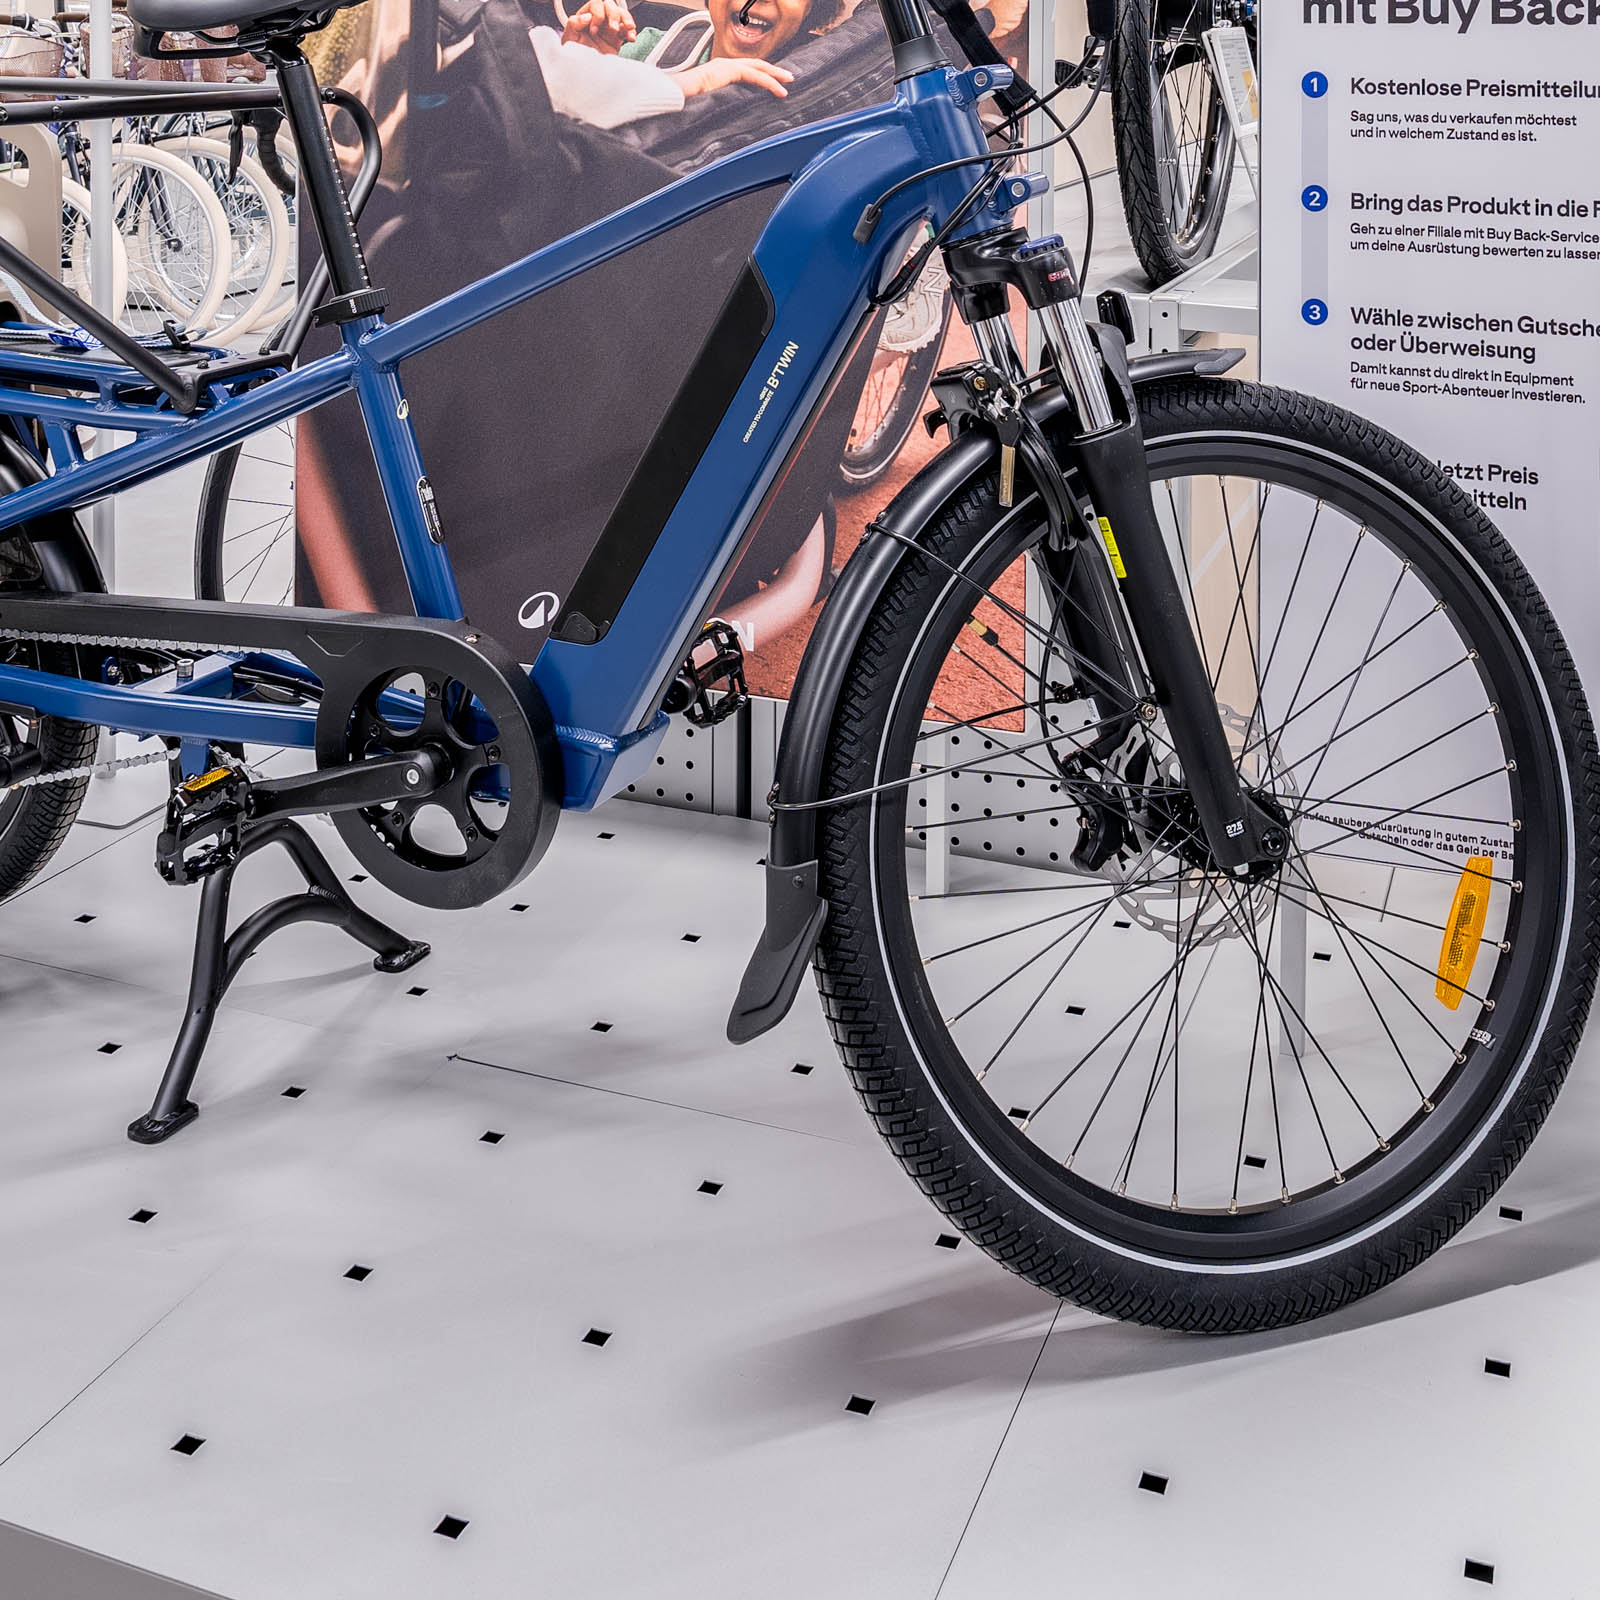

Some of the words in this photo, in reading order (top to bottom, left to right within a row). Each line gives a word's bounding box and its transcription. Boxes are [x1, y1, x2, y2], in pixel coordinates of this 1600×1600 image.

[1351, 77, 1462, 97] Kostenlose
[1350, 111, 1374, 125] Sag
[1376, 113, 1402, 125] uns,
[1404, 113, 1426, 123] was
[1431, 111, 1448, 124] du
[1450, 111, 1512, 125] verkaufen
[1515, 112, 1577, 127] möchtest
[1350, 127, 1374, 139] und
[1376, 128, 1386, 139] in
[1388, 127, 1444, 140] welchem
[1446, 128, 1499, 142] Zustand
[1501, 132, 1514, 142] es
[1517, 129, 1537, 142] ist.
[1308, 191, 1321, 206] 2
[1351, 193, 1403, 216] Bring
[1407, 194, 1443, 213] das
[1447, 196, 1531, 216] Produkt
[1535, 198, 1552, 216] in
[1557, 198, 1588, 218] die
[1350, 223, 1376, 236] Geh
[1378, 226, 1392, 236] zu
[1394, 224, 1425, 237] einer
[1427, 225, 1461, 238] Filiale
[1463, 226, 1485, 240] mit
[1487, 228, 1511, 244] Buy
[1350, 242, 1369, 252] um
[1372, 240, 1405, 253] deine
[1408, 241, 1480, 258] Ausrüstung
[1483, 244, 1543, 258] bewerten
[1545, 248, 1561, 259] zu
[1308, 304, 1321, 320] 3
[1351, 307, 1414, 327] Wähle
[1417, 311, 1513, 333] zwischen
[1351, 335, 1396, 353] oder
[1400, 331, 1536, 364] Überweisung
[1350, 361, 1387, 376] Damit
[1389, 362, 1431, 379] kannst
[1433, 365, 1449, 379] du
[1451, 366, 1488, 382] direkt
[1491, 369, 1502, 382] in
[1504, 370, 1574, 388] Equipment
[1350, 378, 1367, 390] für
[1370, 382, 1400, 392] neue
[1402, 380, 1509, 399] Sport-Abenteuer
[1512, 387, 1586, 404] investieren.
[1488, 464, 1539, 485] Preis
[1472, 489, 1527, 511] itteln
[1333, 815, 1372, 829] saubere
[1373, 821, 1431, 839] Ausrüstung
[1434, 828, 1443, 839] in
[1445, 831, 1478, 845] gutem
[1411, 839, 1434, 849] oder
[1436, 841, 1454, 853] das
[1456, 844, 1480, 856] Geld
[1482, 850, 1499, 860] per
